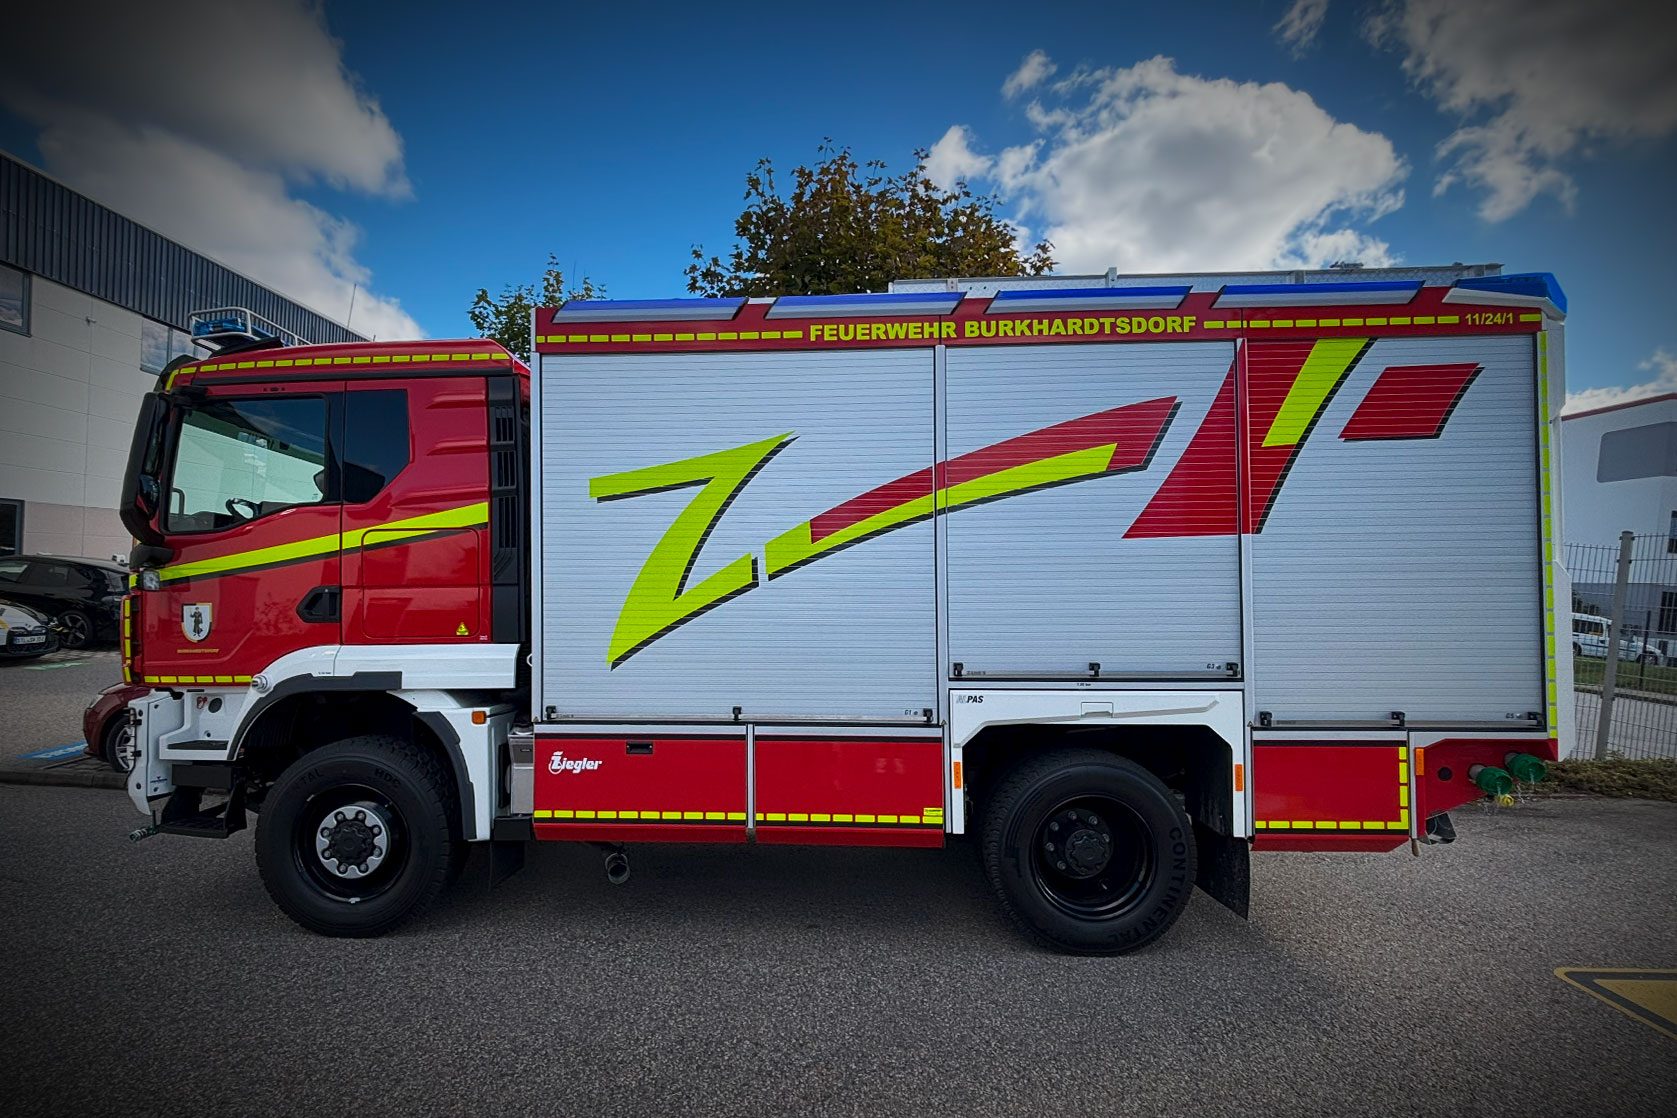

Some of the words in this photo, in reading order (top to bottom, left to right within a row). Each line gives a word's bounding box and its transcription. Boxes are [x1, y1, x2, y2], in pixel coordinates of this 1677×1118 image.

[809, 321, 957, 342] FEUERWEHR
[964, 316, 1197, 339] BURKHARDTSDORF
[1465, 312, 1514, 325] 11/24/1
[548, 751, 603, 775] Ziegler
[1108, 826, 1187, 943] CONTINENTAL
